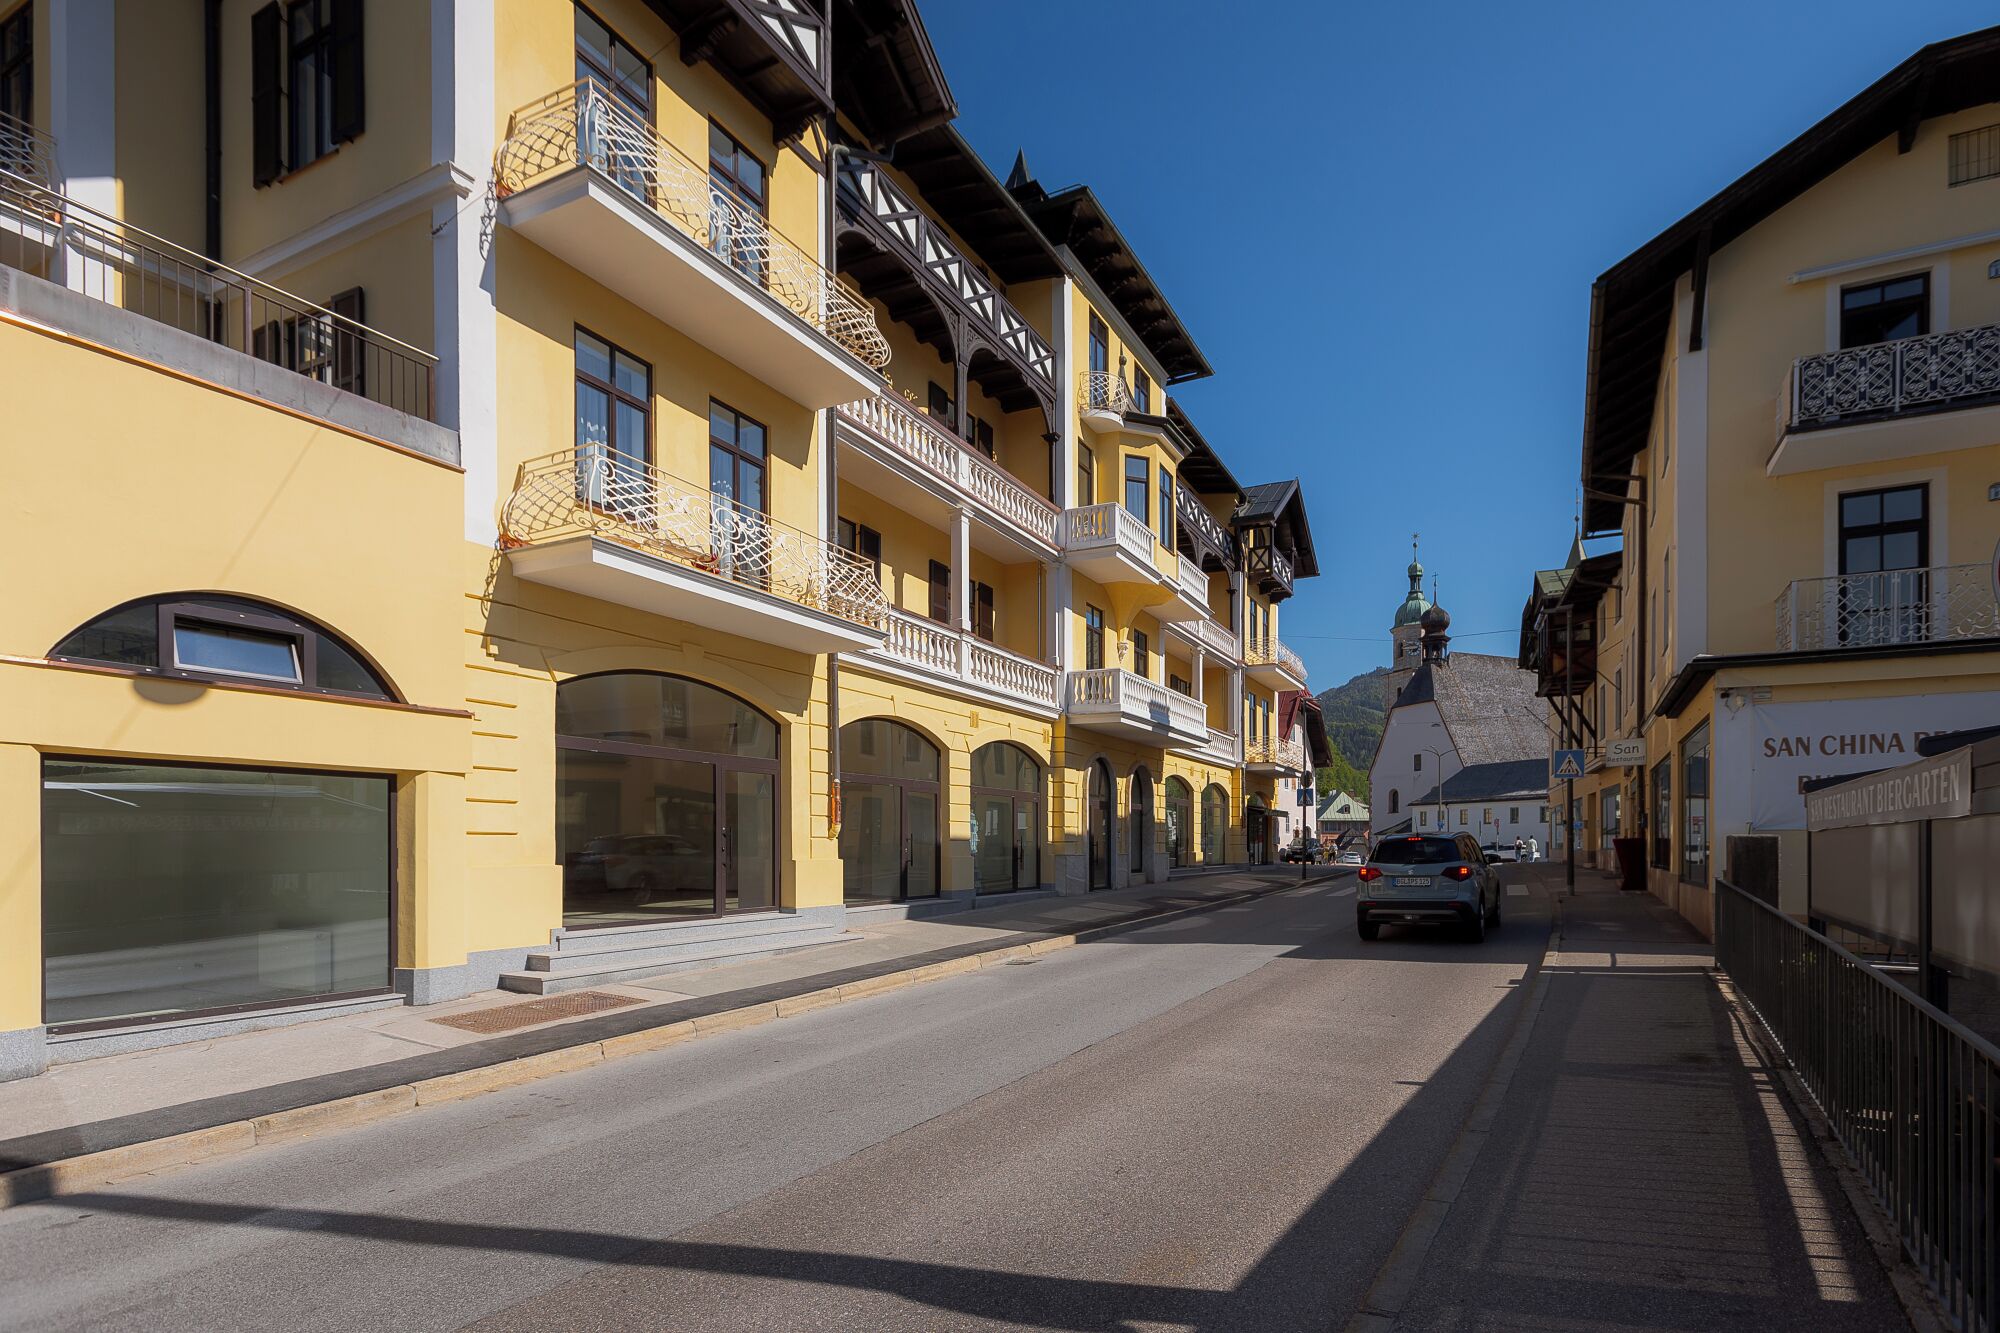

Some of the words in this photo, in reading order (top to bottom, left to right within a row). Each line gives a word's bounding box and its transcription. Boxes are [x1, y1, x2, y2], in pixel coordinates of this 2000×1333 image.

[1613, 743, 1640, 755] San
[1763, 736, 1811, 757] SAN
[1819, 732, 1905, 756] CHINA
[1811, 796, 1824, 821] SAN
[1824, 784, 1874, 819] RESTAURANT
[1876, 763, 1961, 813] BIERGARTEN
